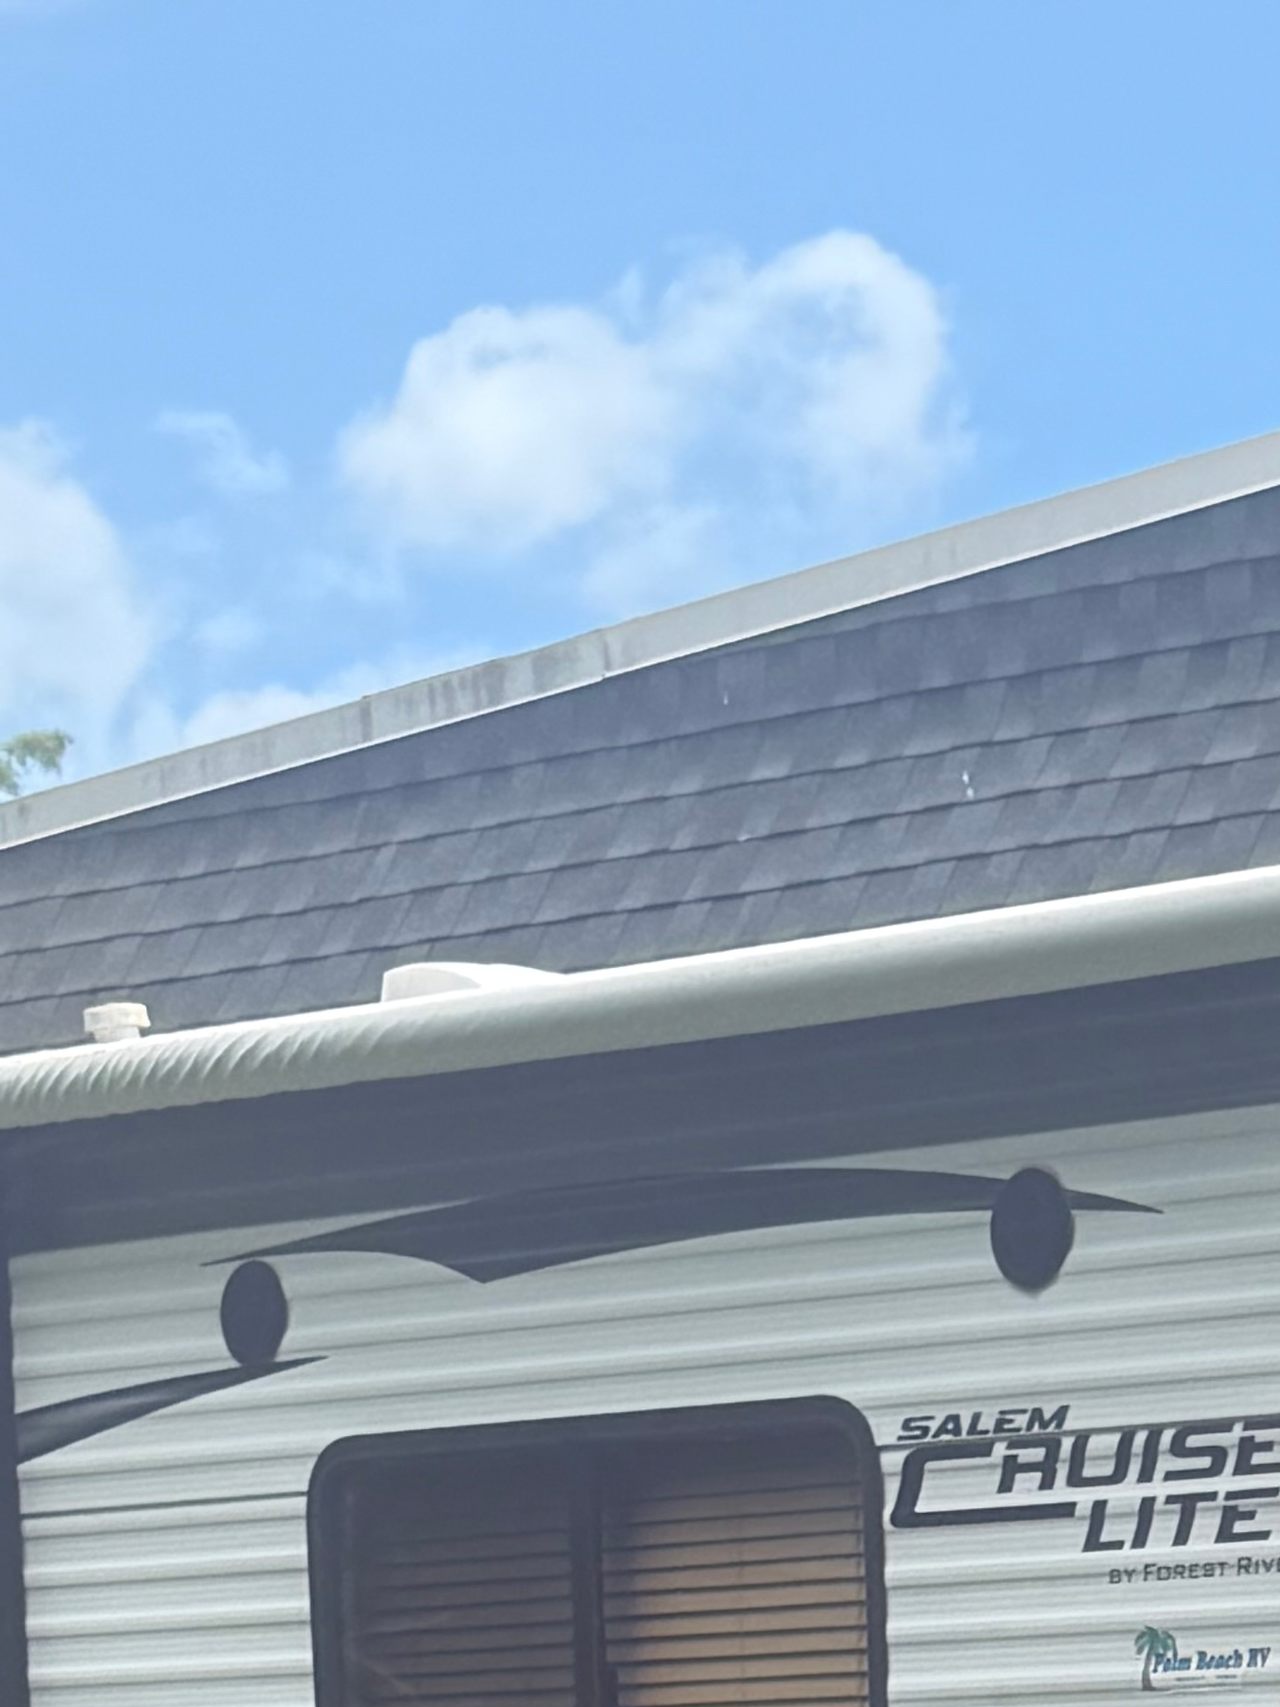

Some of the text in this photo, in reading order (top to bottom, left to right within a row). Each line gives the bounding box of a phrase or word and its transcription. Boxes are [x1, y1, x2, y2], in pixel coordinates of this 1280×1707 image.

[897, 1405, 1070, 1442] SALEM
[1081, 1486, 1280, 1553] LITE
[1109, 1568, 1136, 1584] BY
[1143, 1562, 1229, 1583] FOREST
[1196, 1648, 1243, 1671] Beach
[1246, 1646, 1272, 1668] RV
